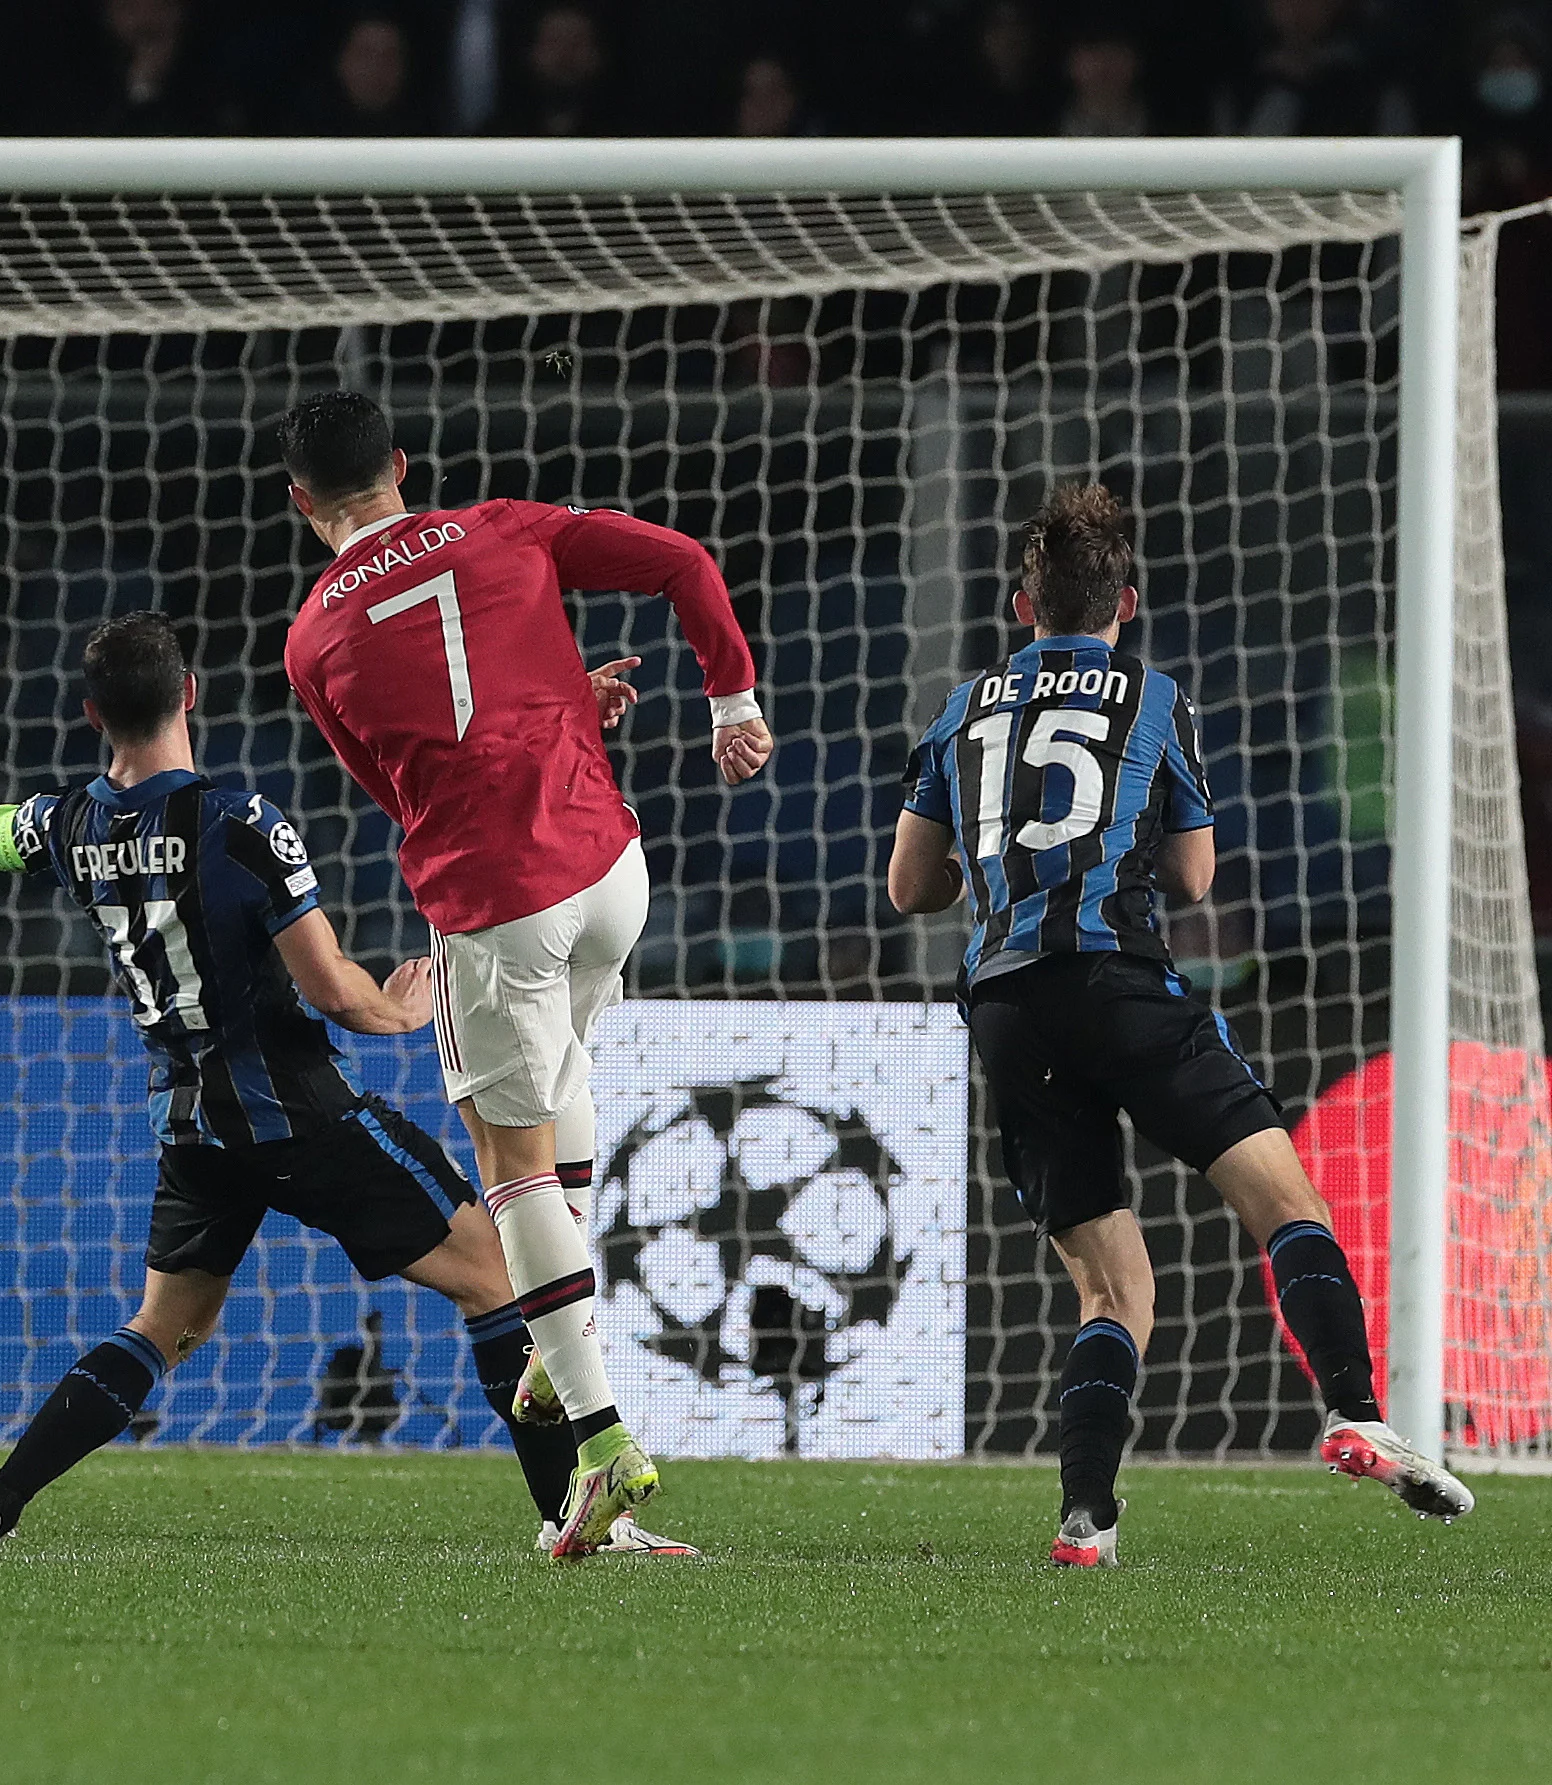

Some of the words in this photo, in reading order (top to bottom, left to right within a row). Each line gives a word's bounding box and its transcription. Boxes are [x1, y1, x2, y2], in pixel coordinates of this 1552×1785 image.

[321, 521, 467, 608] RONALDO
[365, 568, 475, 742] 7
[979, 674, 1023, 708] DE
[1031, 669, 1129, 704] ROON
[967, 709, 1110, 861] 15
[71, 836, 186, 882] FREULER
